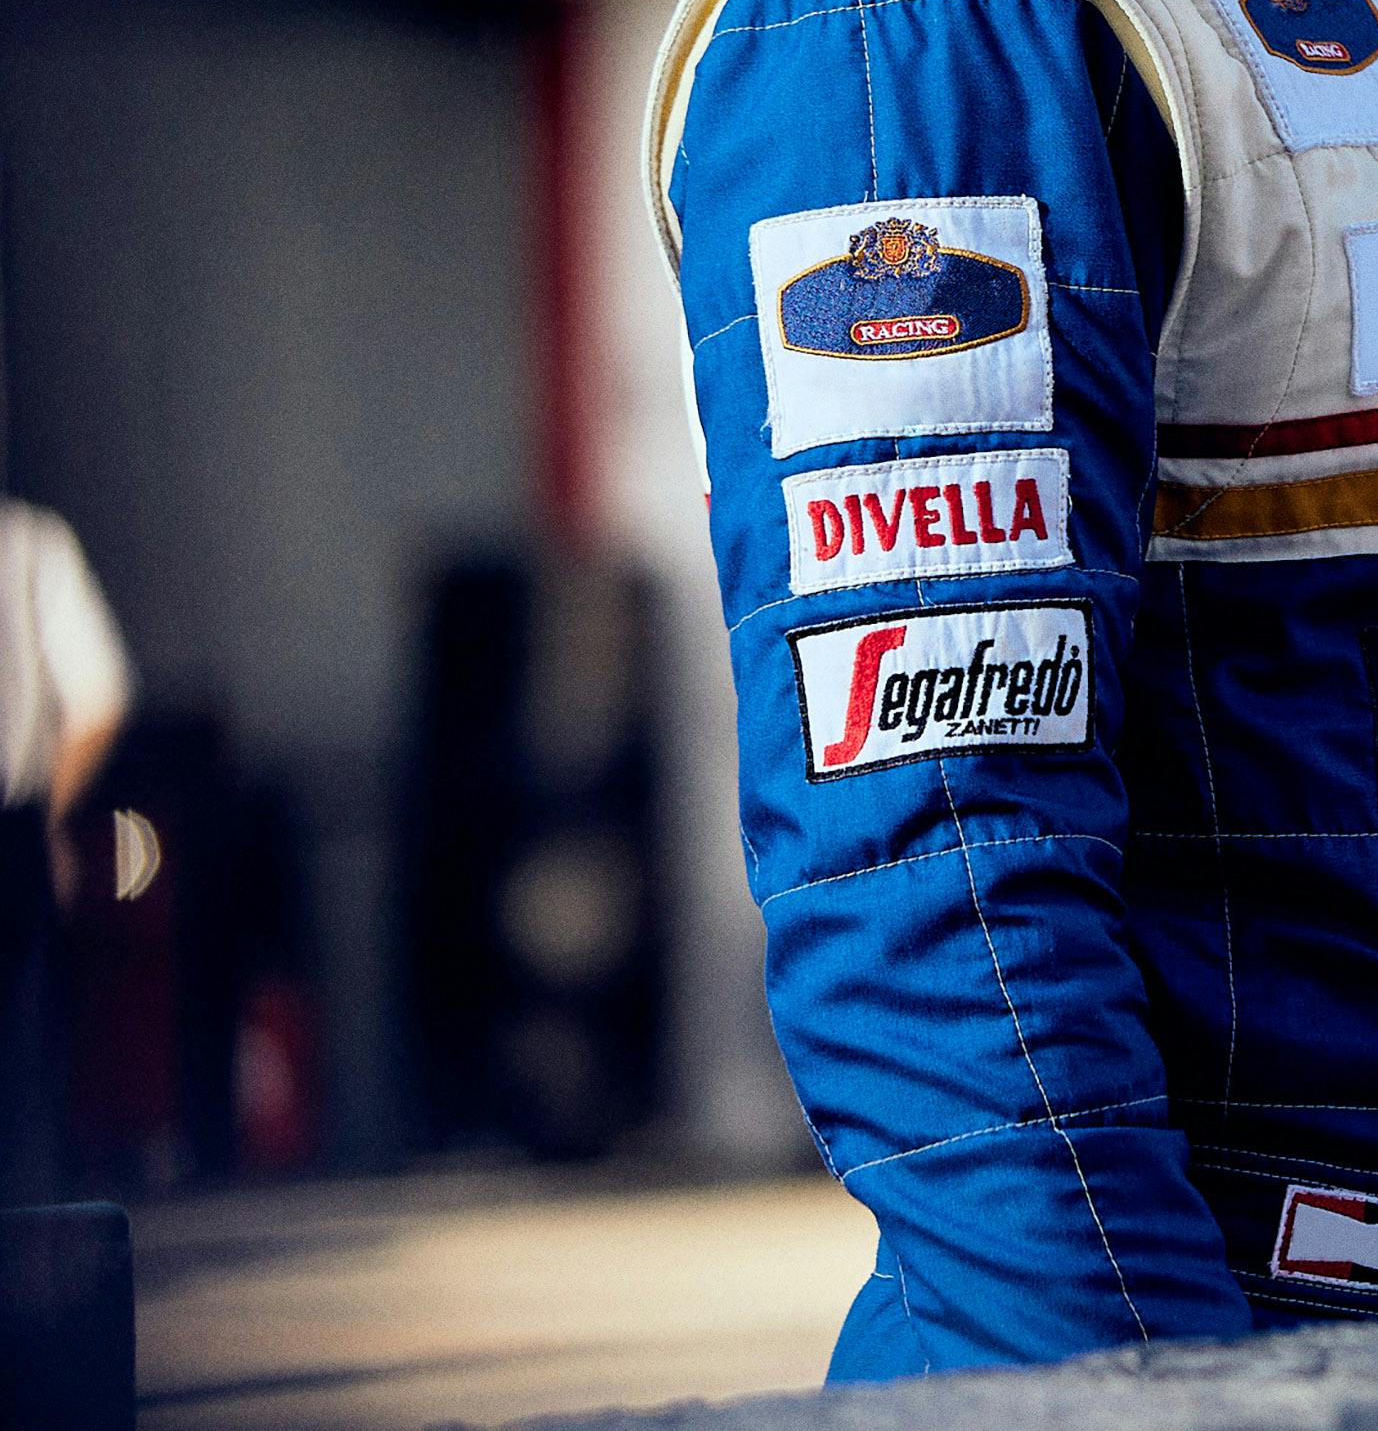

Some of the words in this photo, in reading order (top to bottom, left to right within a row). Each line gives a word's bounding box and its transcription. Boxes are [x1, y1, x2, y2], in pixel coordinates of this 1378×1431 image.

[859, 317, 950, 342] RACING
[807, 478, 1049, 561] DIVELLA
[823, 625, 1083, 767] Segafredo
